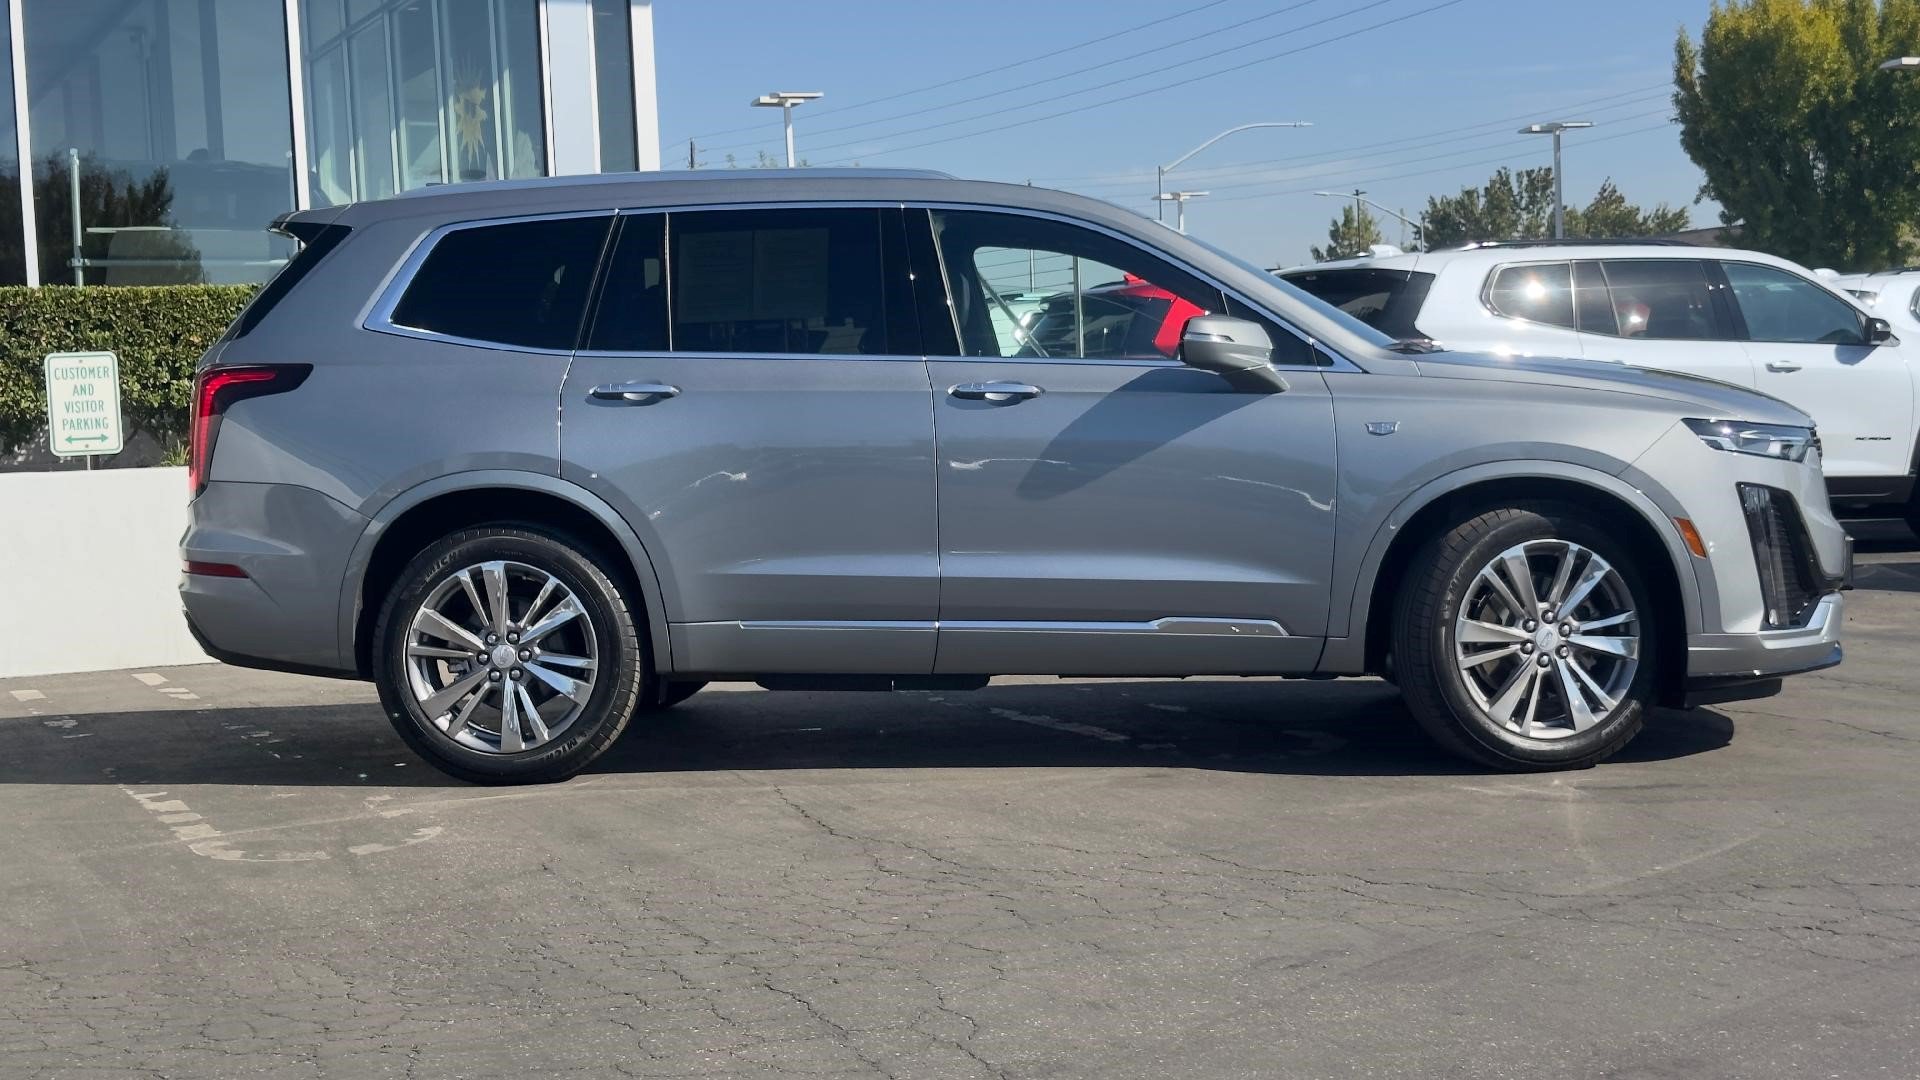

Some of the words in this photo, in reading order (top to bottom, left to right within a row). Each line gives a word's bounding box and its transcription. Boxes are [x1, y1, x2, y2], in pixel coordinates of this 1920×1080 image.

[54, 367, 110, 381] CUSTOMER
[72, 383, 95, 397] AND
[64, 399, 104, 414] VISITOR
[62, 416, 109, 431] PARKING
